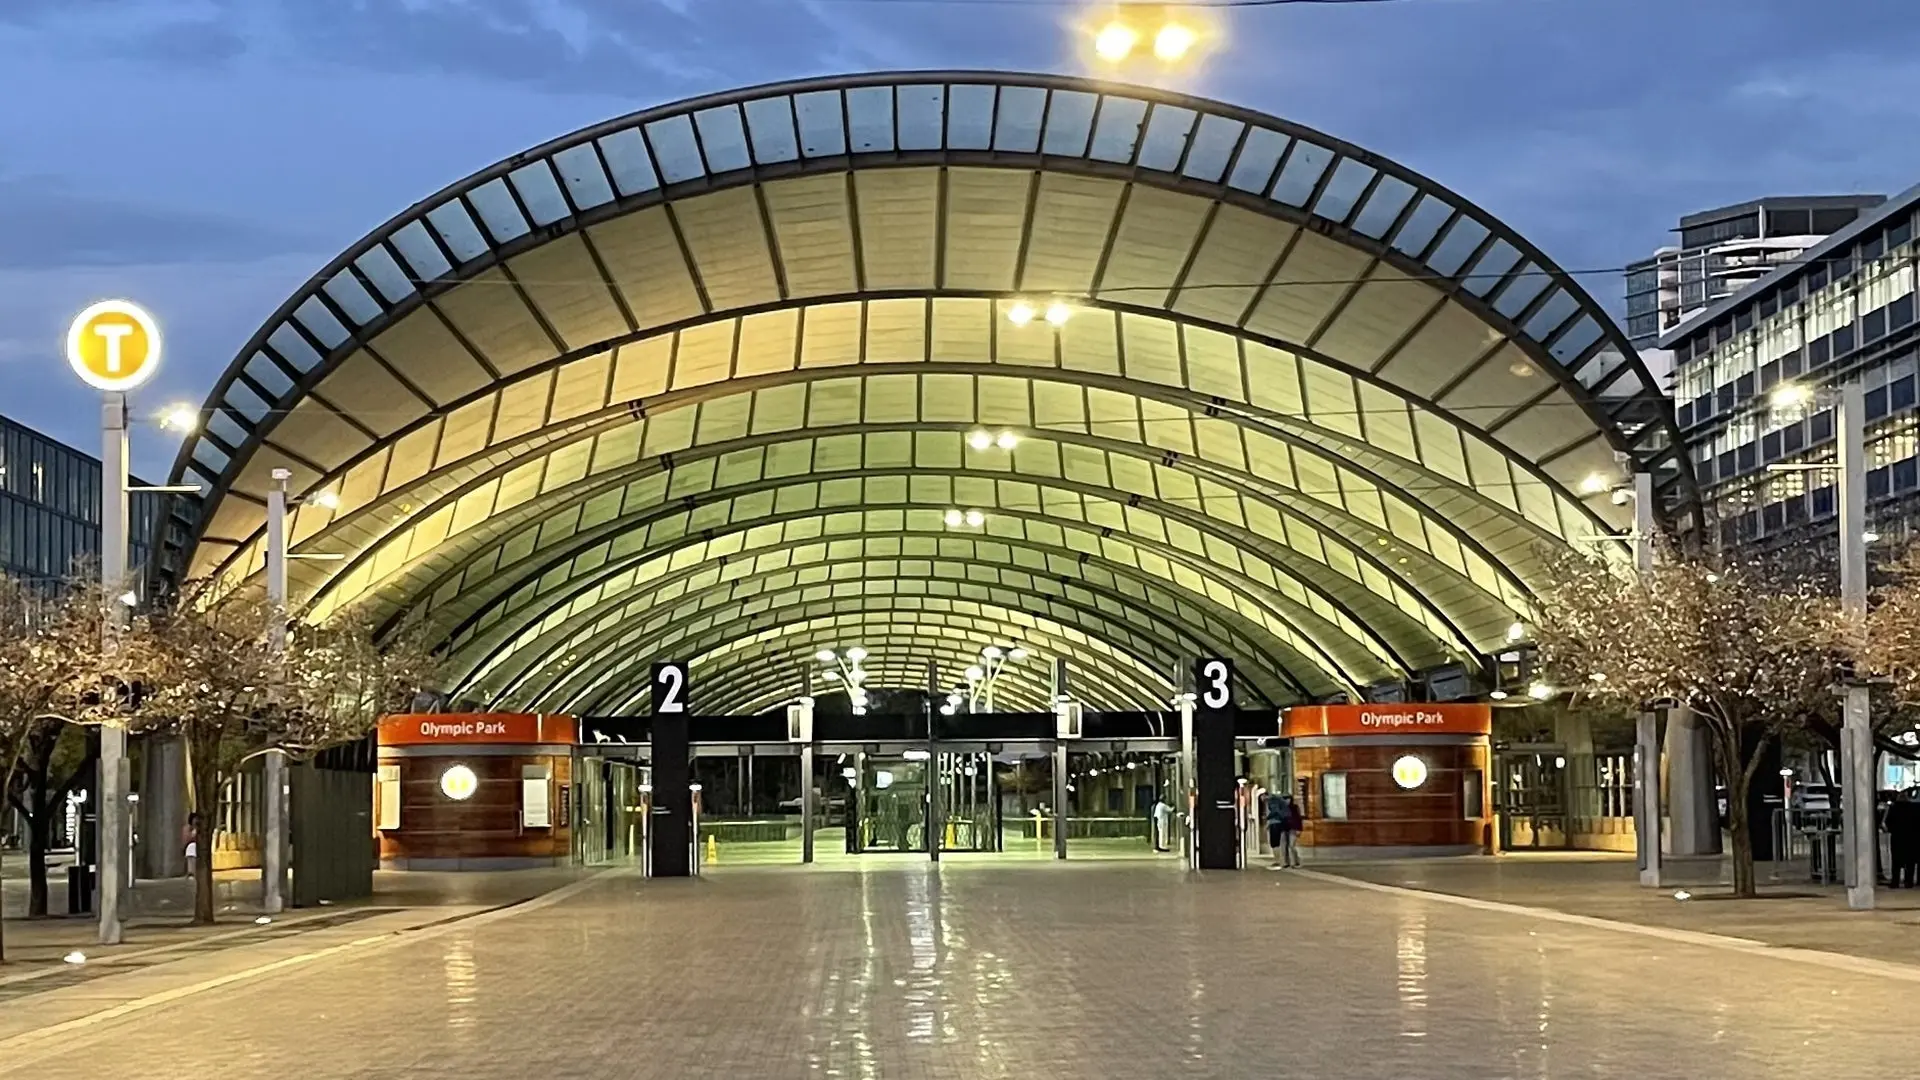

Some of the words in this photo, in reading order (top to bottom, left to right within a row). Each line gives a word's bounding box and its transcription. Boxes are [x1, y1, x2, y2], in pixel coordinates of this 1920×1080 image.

[95, 325, 133, 370] T
[658, 665, 684, 713] 2
[1203, 660, 1230, 709] 3
[420, 721, 474, 737] Olympic
[475, 721, 506, 734] Park
[1360, 711, 1414, 727] Olympic
[1416, 711, 1444, 724] Park
